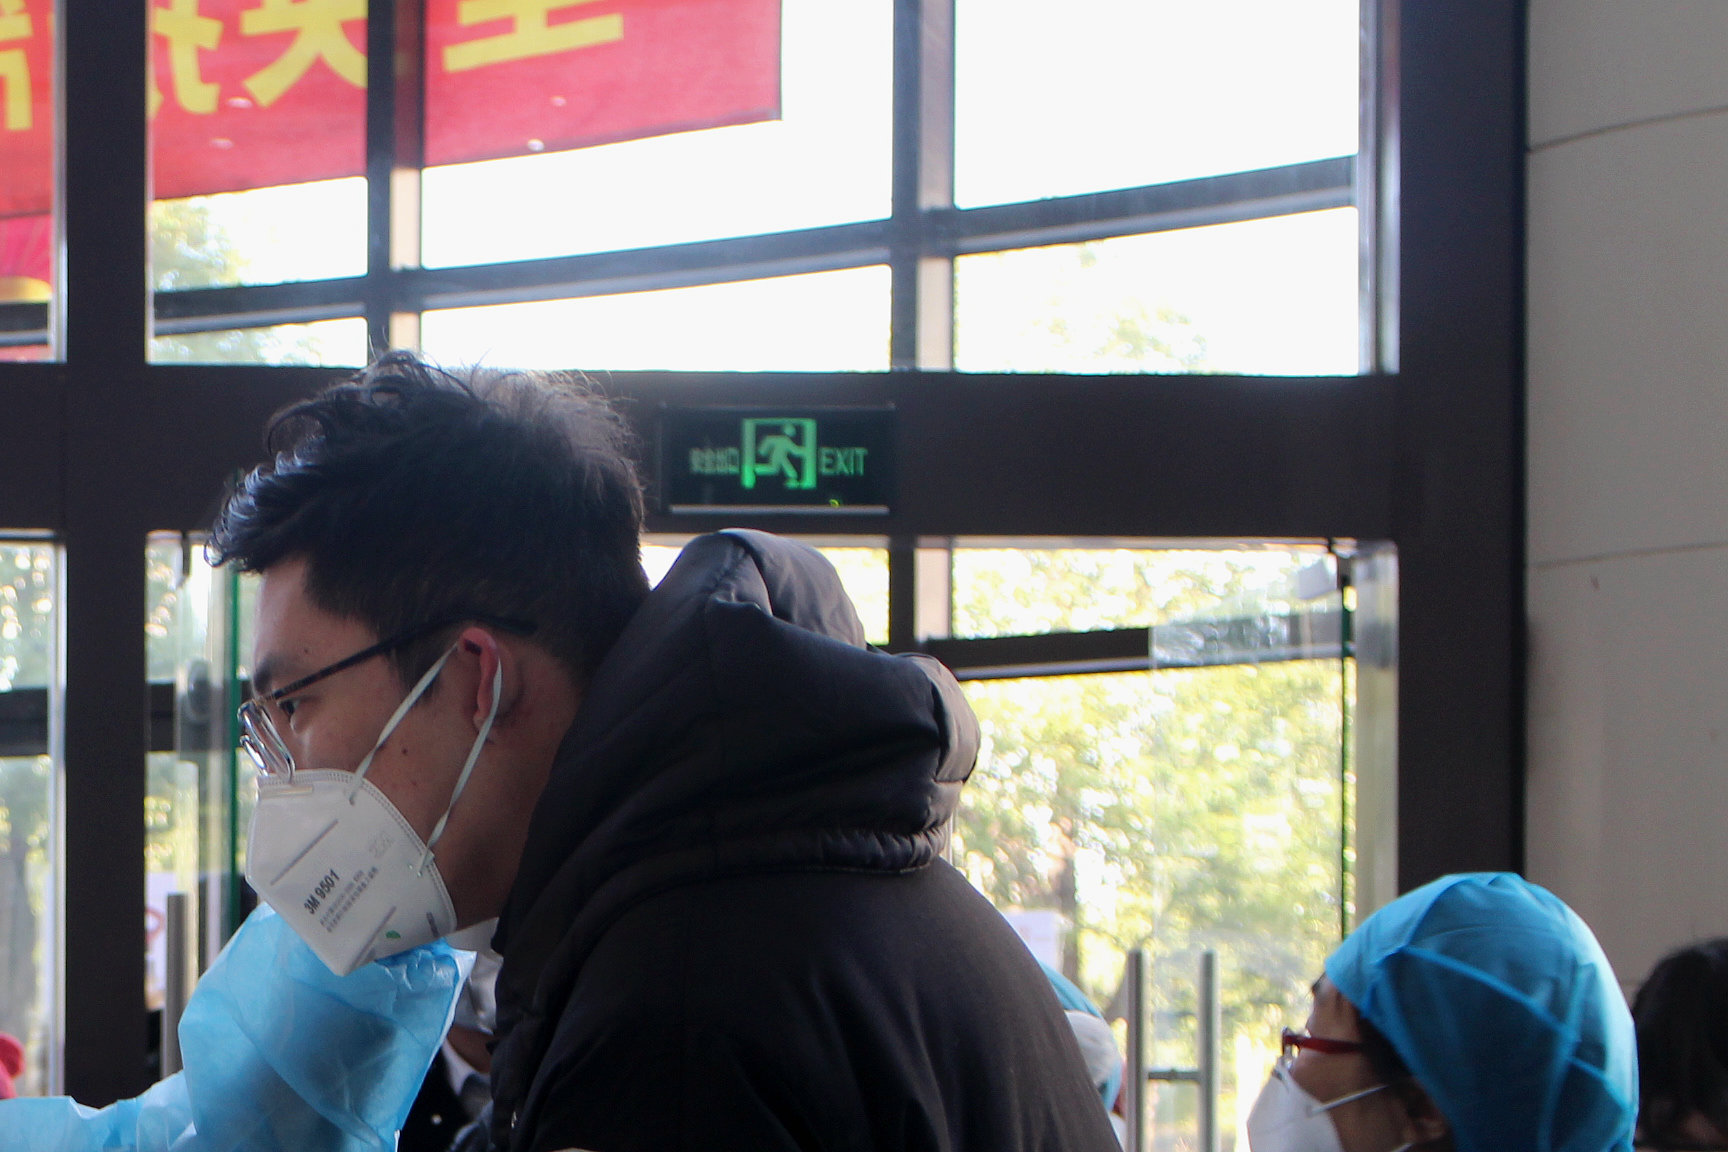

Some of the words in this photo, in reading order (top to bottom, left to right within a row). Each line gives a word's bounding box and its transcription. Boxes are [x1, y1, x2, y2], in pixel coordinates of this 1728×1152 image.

[820, 447, 868, 476] EXIT
[304, 895, 320, 914] 3M
[316, 869, 339, 898] 9501
